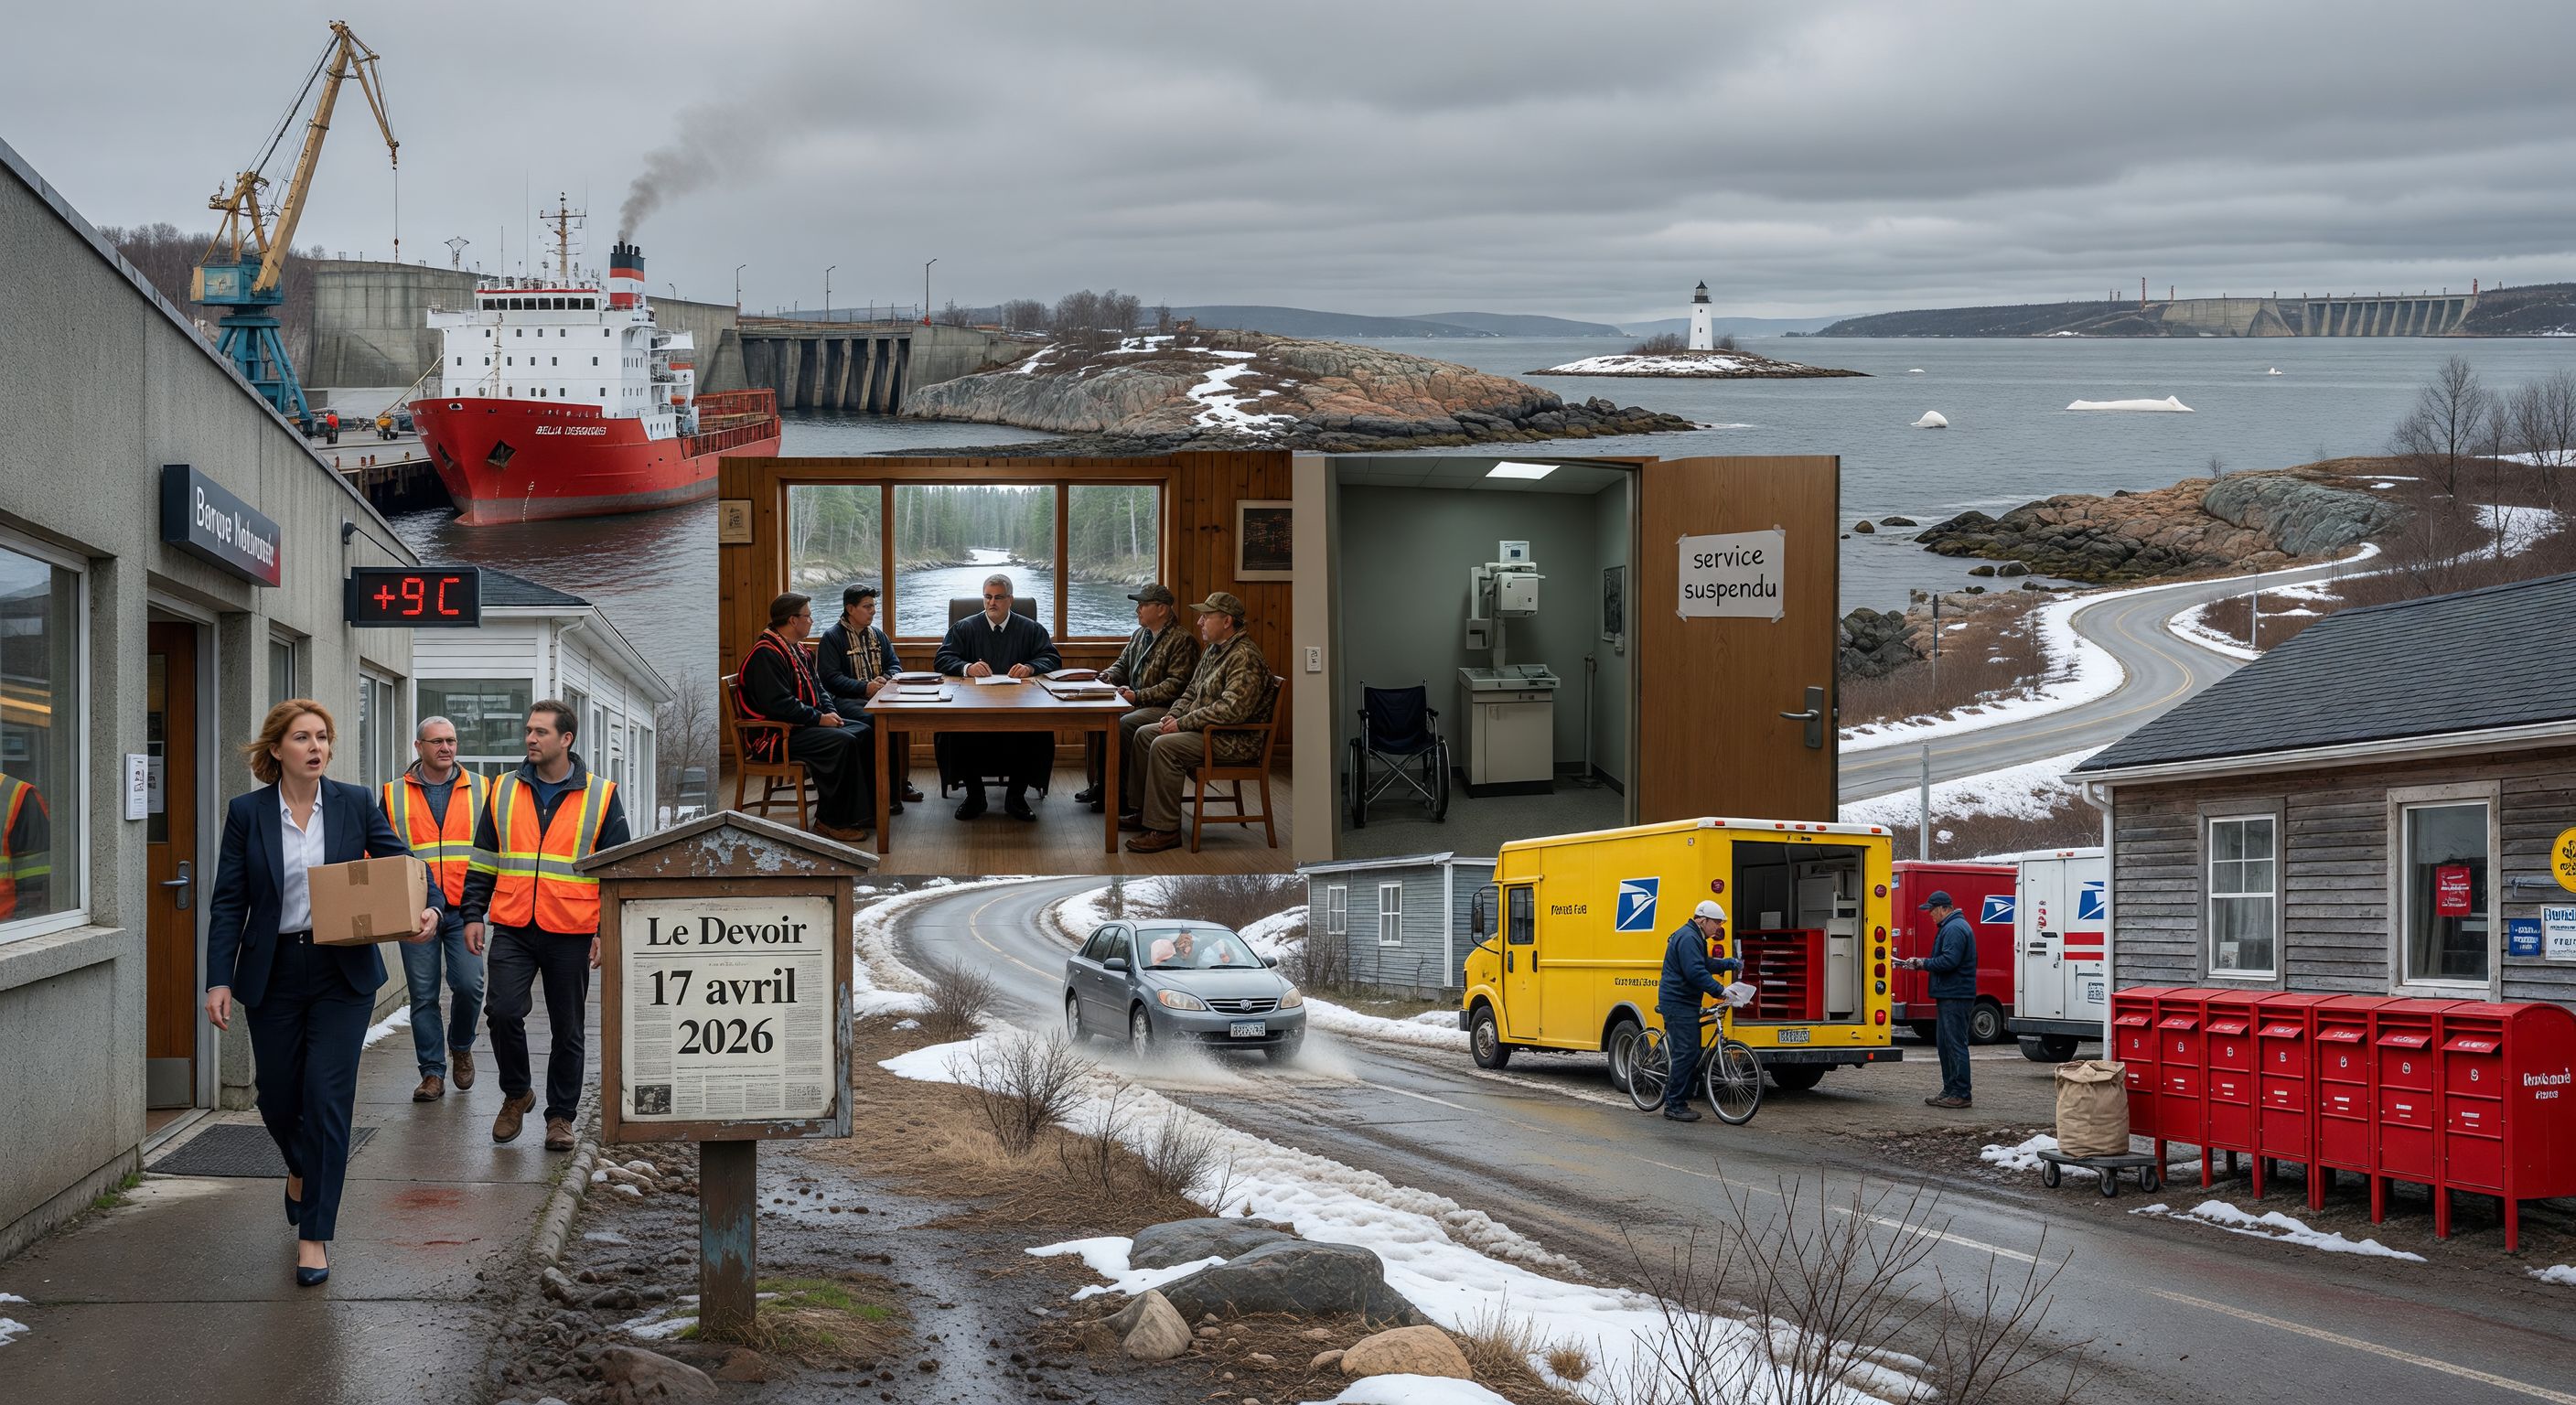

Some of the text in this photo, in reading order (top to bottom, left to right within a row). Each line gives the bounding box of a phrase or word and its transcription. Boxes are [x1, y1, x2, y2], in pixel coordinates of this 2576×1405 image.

[1693, 544, 1765, 569] service
[1684, 574, 1776, 606] suspendu
[646, 915, 807, 946] Le Devoir
[648, 970, 693, 1007] 17
[705, 967, 799, 1006] avril
[676, 1016, 774, 1056] 2026
